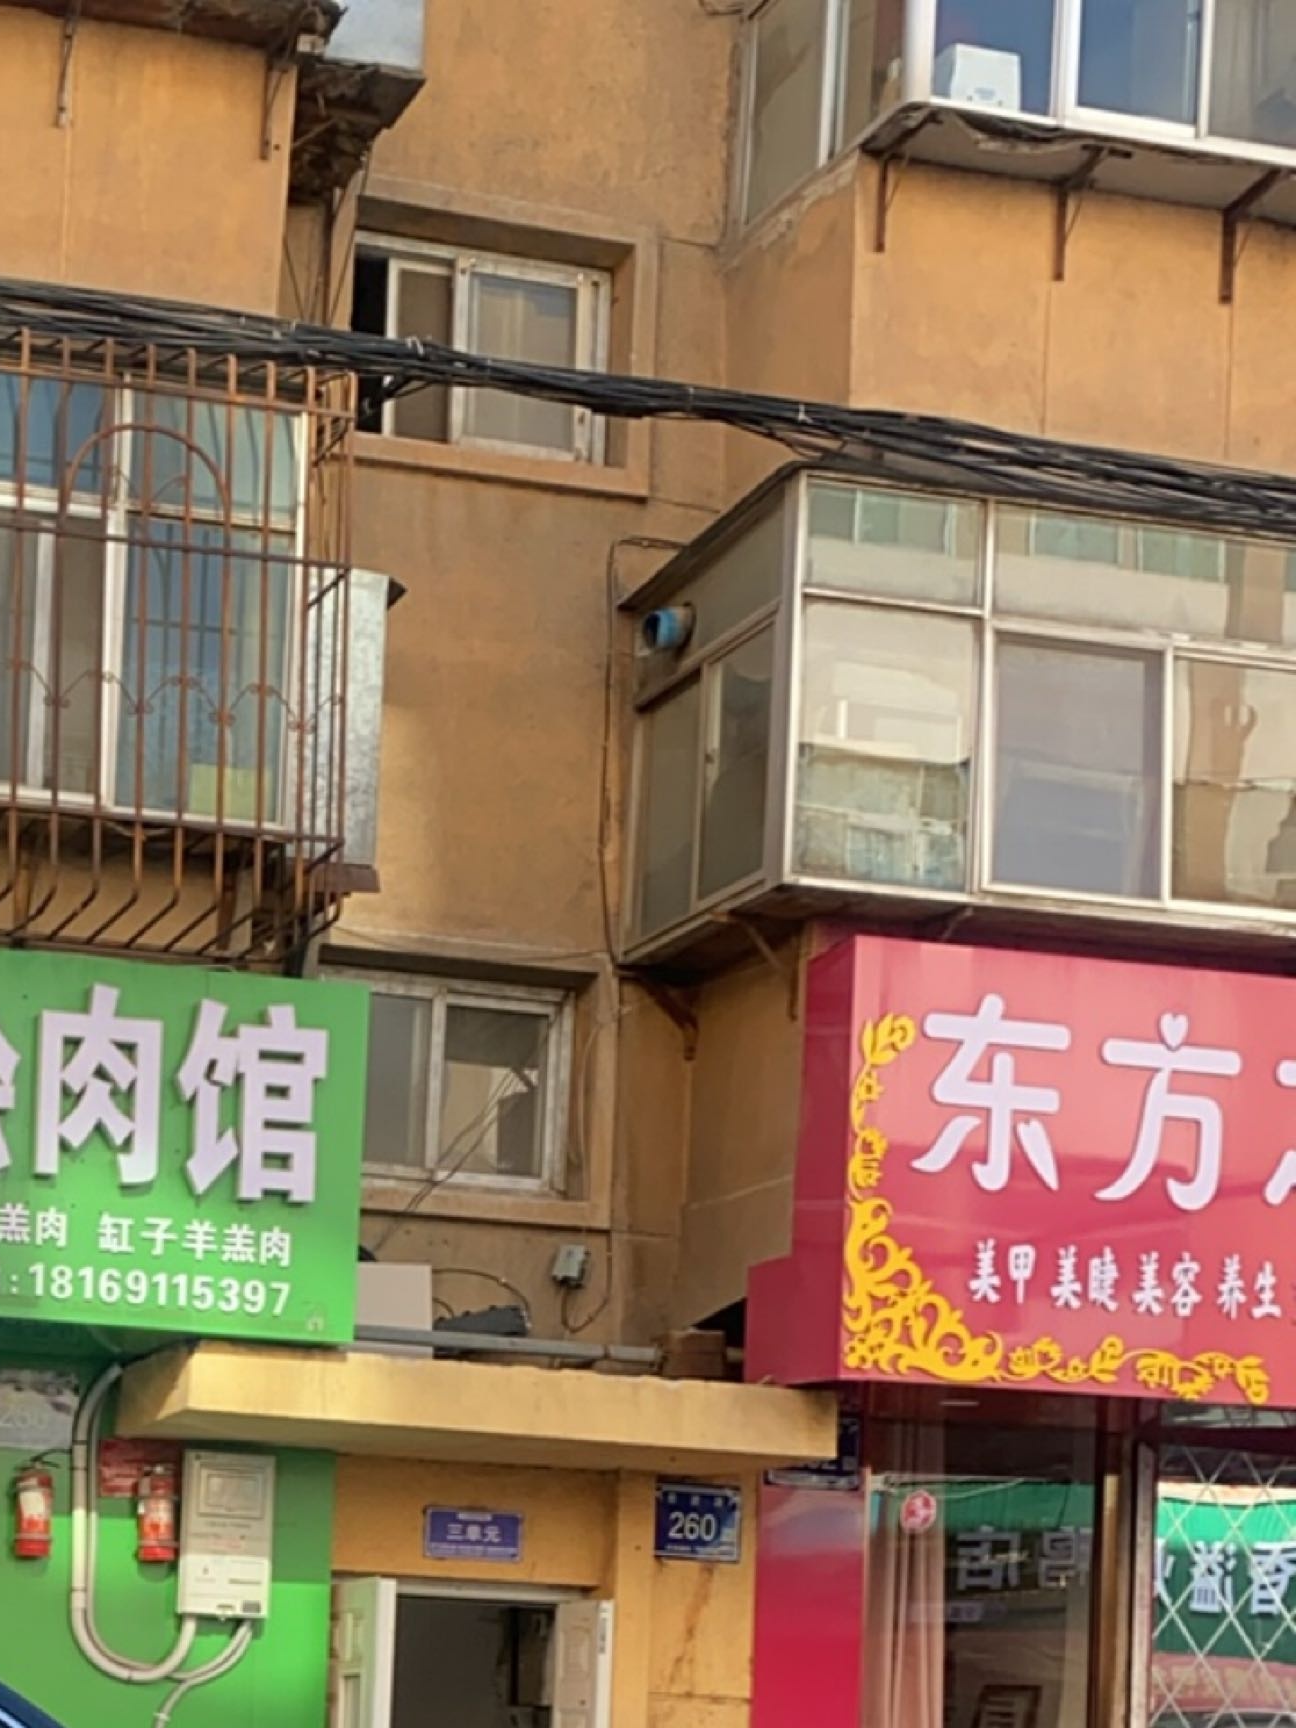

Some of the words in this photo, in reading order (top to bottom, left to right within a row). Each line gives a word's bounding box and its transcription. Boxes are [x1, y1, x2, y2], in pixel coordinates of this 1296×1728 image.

[911, 993, 1296, 1211] 东方
[97, 1210, 291, 1267] 缸子羊羔肉
[968, 1238, 1036, 1304] 美甲
[1131, 1250, 1202, 1317] 美容
[1216, 1253, 1282, 1320] 养生
[668, 1510, 717, 1541] 260
